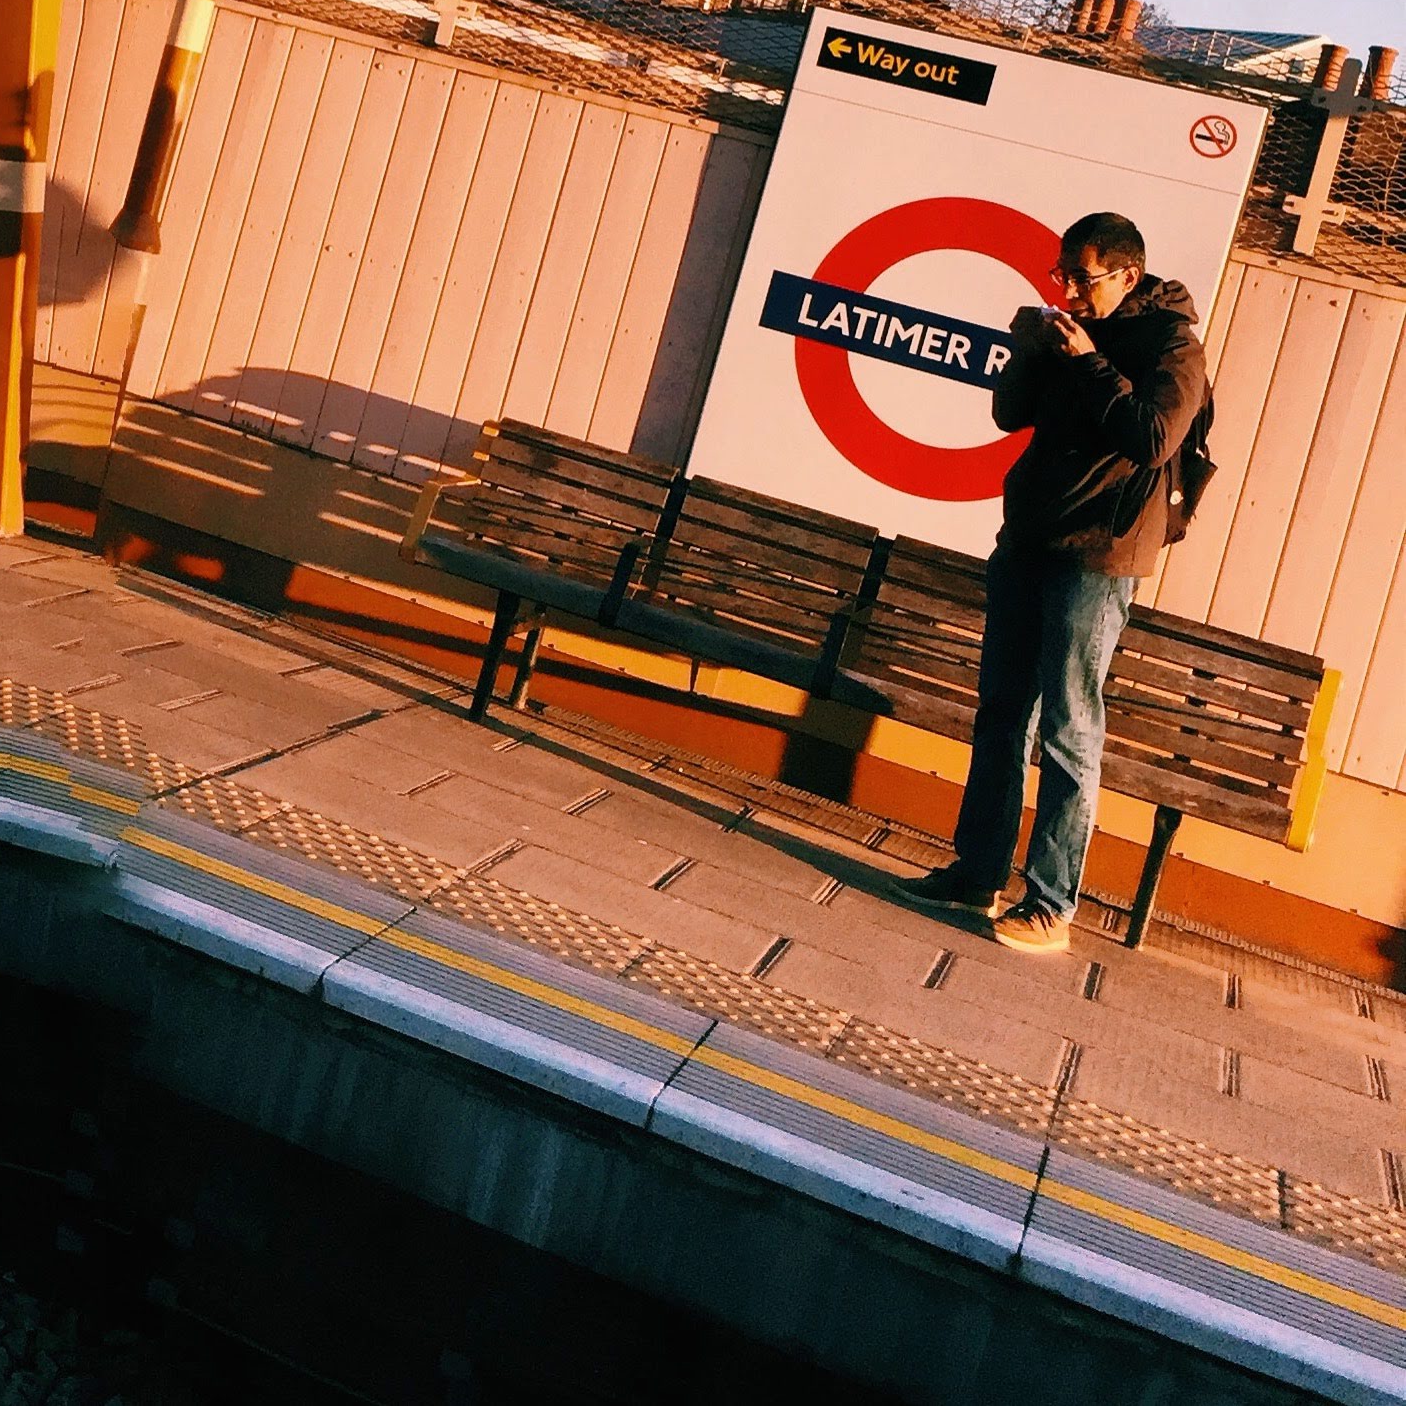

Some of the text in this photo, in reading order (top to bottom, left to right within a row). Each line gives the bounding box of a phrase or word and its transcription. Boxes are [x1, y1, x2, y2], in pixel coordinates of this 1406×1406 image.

[857, 42, 959, 85] Way out
[797, 293, 972, 370] LATIMER
